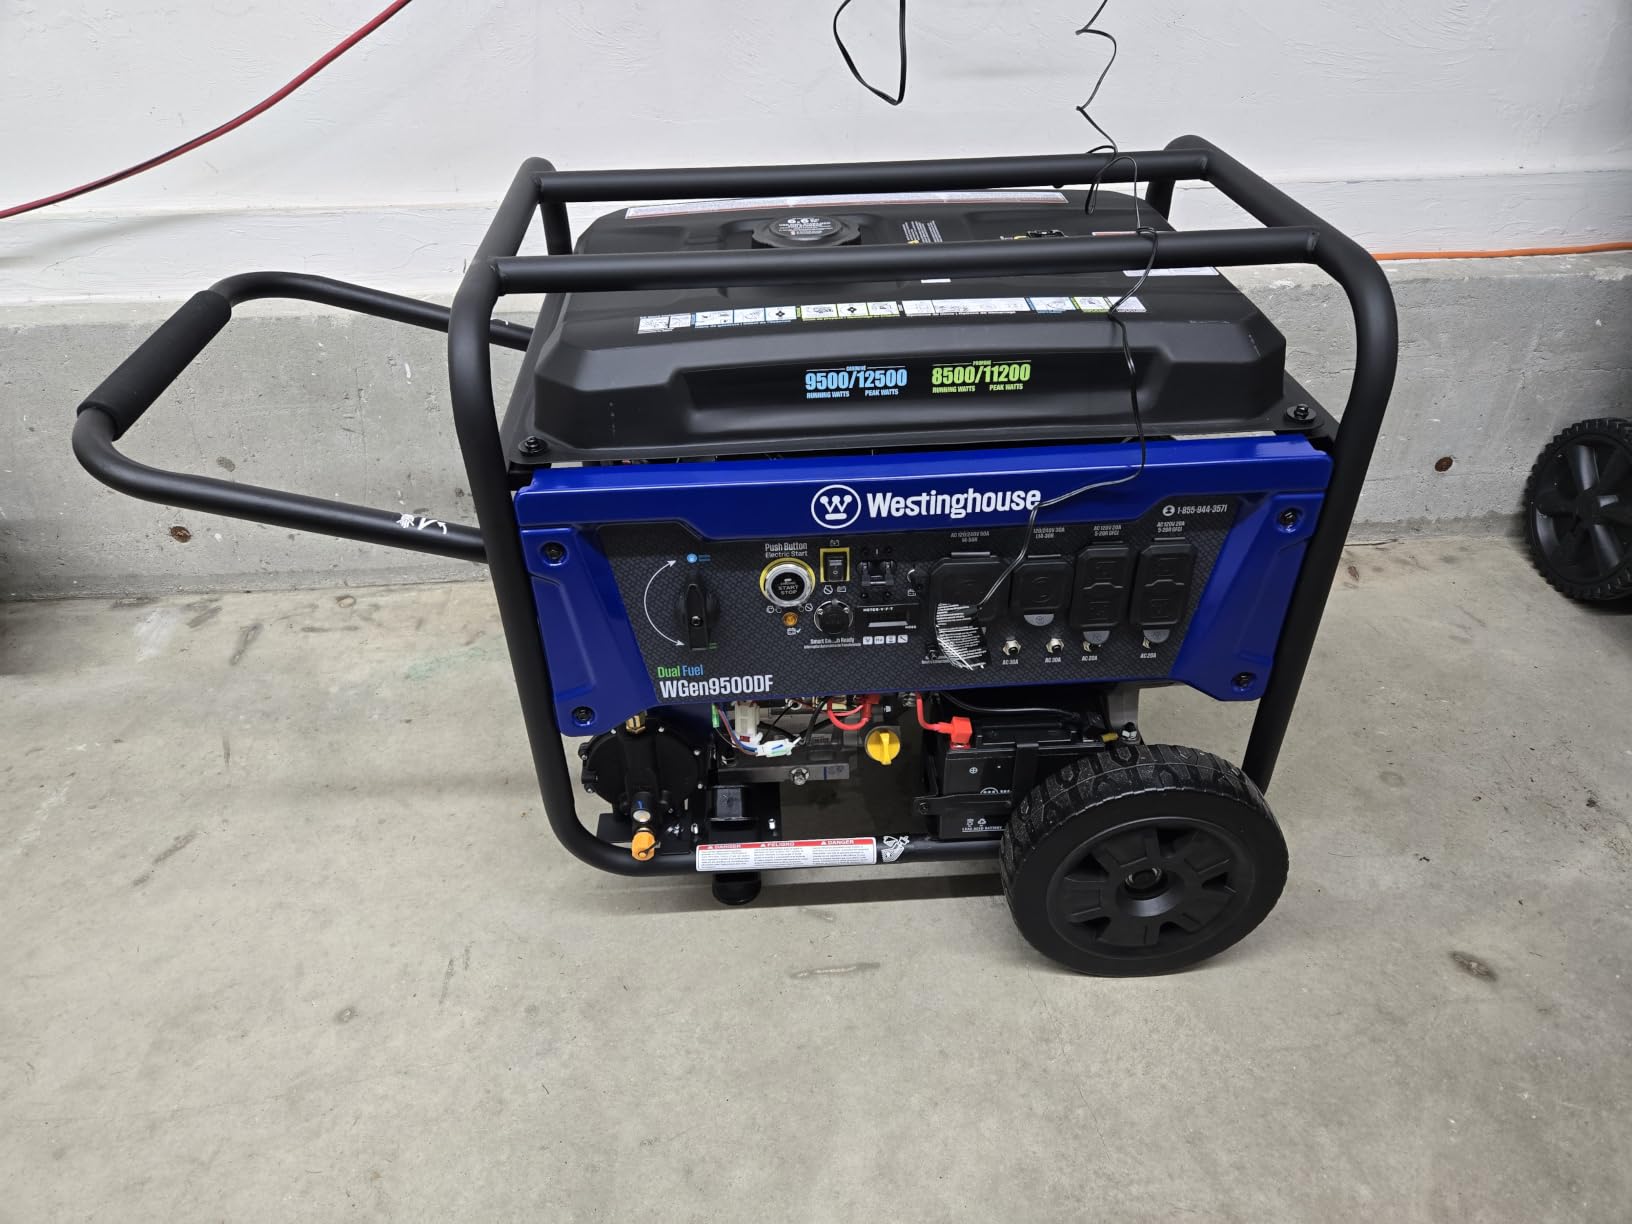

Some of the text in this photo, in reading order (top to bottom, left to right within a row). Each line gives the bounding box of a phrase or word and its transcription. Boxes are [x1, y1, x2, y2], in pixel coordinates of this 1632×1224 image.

[931, 363, 1031, 385] 8500/11200
[805, 369, 908, 391] 9500/12500
[864, 388, 899, 397] PEAK WATTS
[932, 385, 976, 394] RUNNING WATTS
[989, 383, 1024, 392] PEAK WATTS
[806, 390, 850, 399] RUNNING WATTS
[866, 488, 1041, 519] Westinghouse
[1177, 504, 1228, 515] 1-855-944-3571
[765, 542, 808, 552] Push Button
[656, 664, 704, 678] Dual Fuel
[659, 674, 774, 699] WGen9500DF
